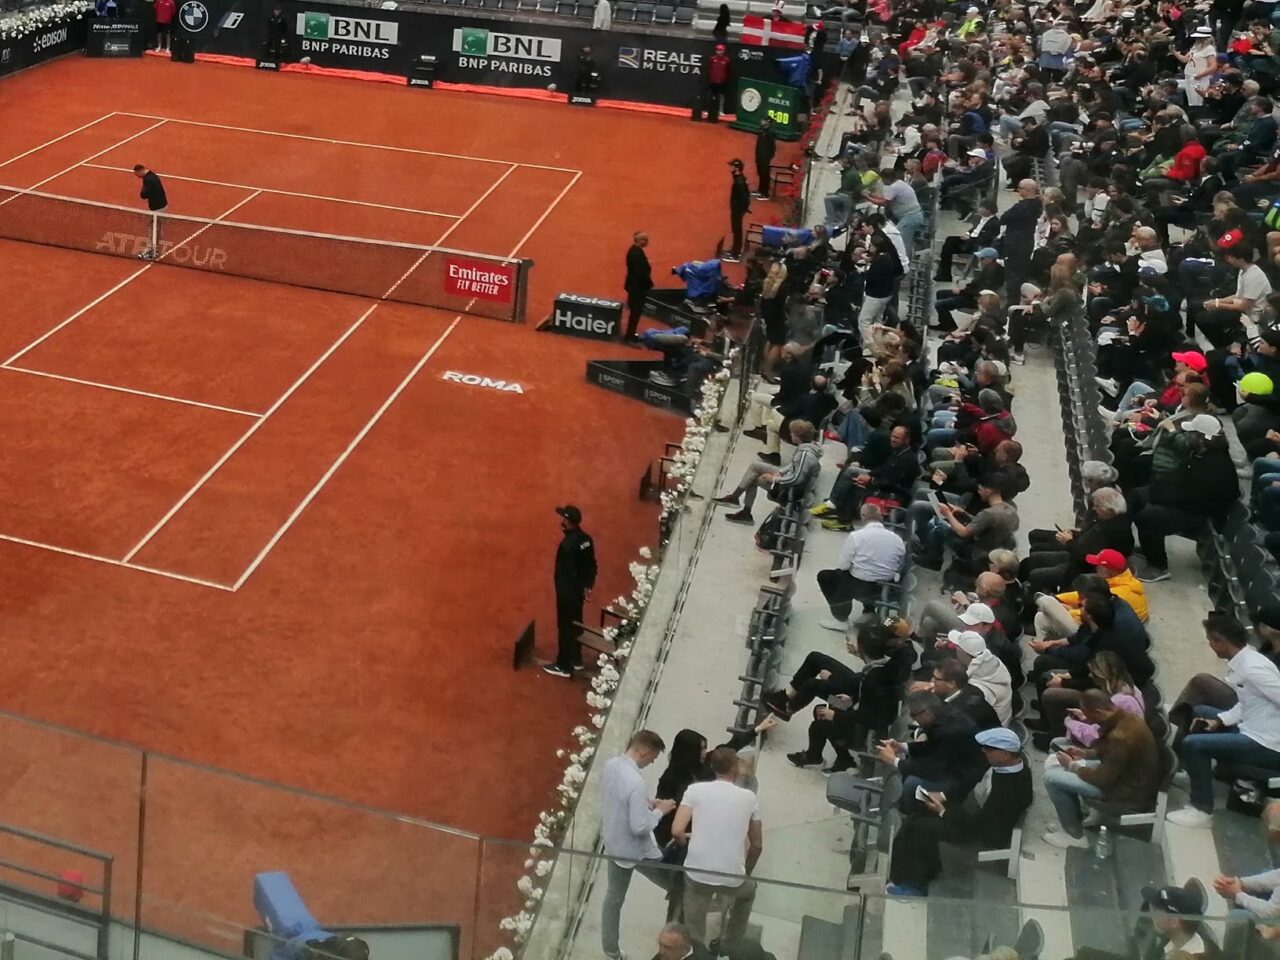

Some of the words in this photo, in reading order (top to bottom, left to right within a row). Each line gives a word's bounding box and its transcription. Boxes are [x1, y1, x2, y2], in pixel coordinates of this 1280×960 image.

[334, 19, 390, 41] BNL
[302, 40, 329, 53] BNP
[332, 43, 390, 59] PARIBAS
[493, 35, 552, 59] BNL
[458, 57, 488, 70] BNP
[491, 60, 552, 77] PARIBAS
[644, 49, 702, 66] REALE
[643, 62, 701, 75] MUTUA
[768, 97, 790, 106] ROLEX
[449, 264, 509, 286] Emirates
[457, 279, 470, 291] FLY
[471, 281, 499, 296] BETTER
[559, 293, 620, 307] Haier
[554, 309, 616, 335] Haier
[442, 370, 524, 394] ROMA
